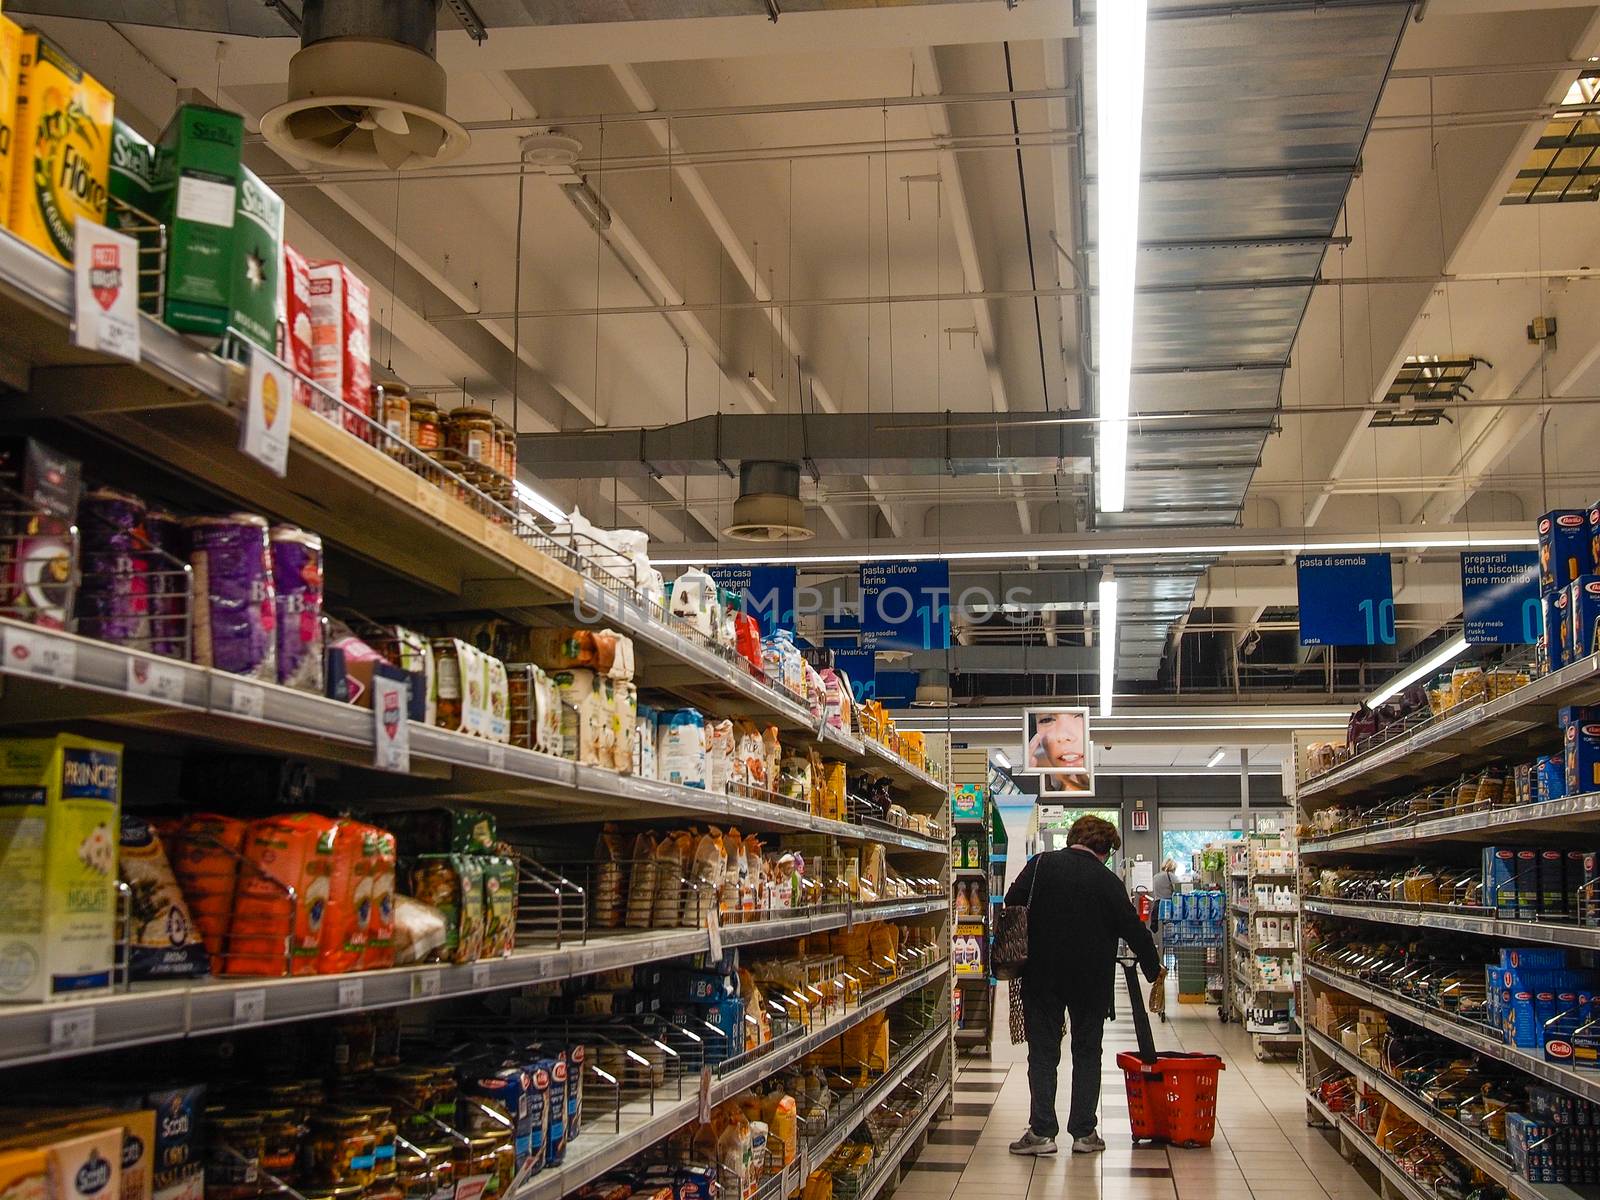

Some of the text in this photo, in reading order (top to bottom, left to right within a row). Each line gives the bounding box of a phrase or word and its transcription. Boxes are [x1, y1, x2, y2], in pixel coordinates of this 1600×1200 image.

[1299, 556, 1366, 568] pasta di semola
[1464, 553, 1507, 565] preparati
[711, 569, 752, 578] carta casa
[862, 564, 918, 576] pasta all'uovo
[1464, 564, 1486, 574] fette
[862, 576, 886, 585] farina
[1465, 574, 1531, 586] pane morbido
[863, 585, 879, 595] riso
[1358, 598, 1396, 645] 10
[916, 605, 951, 650] 11
[1304, 637, 1321, 645] pasta
[706, 1014, 722, 1024] BIO
[1551, 1043, 1570, 1054] Barilla
